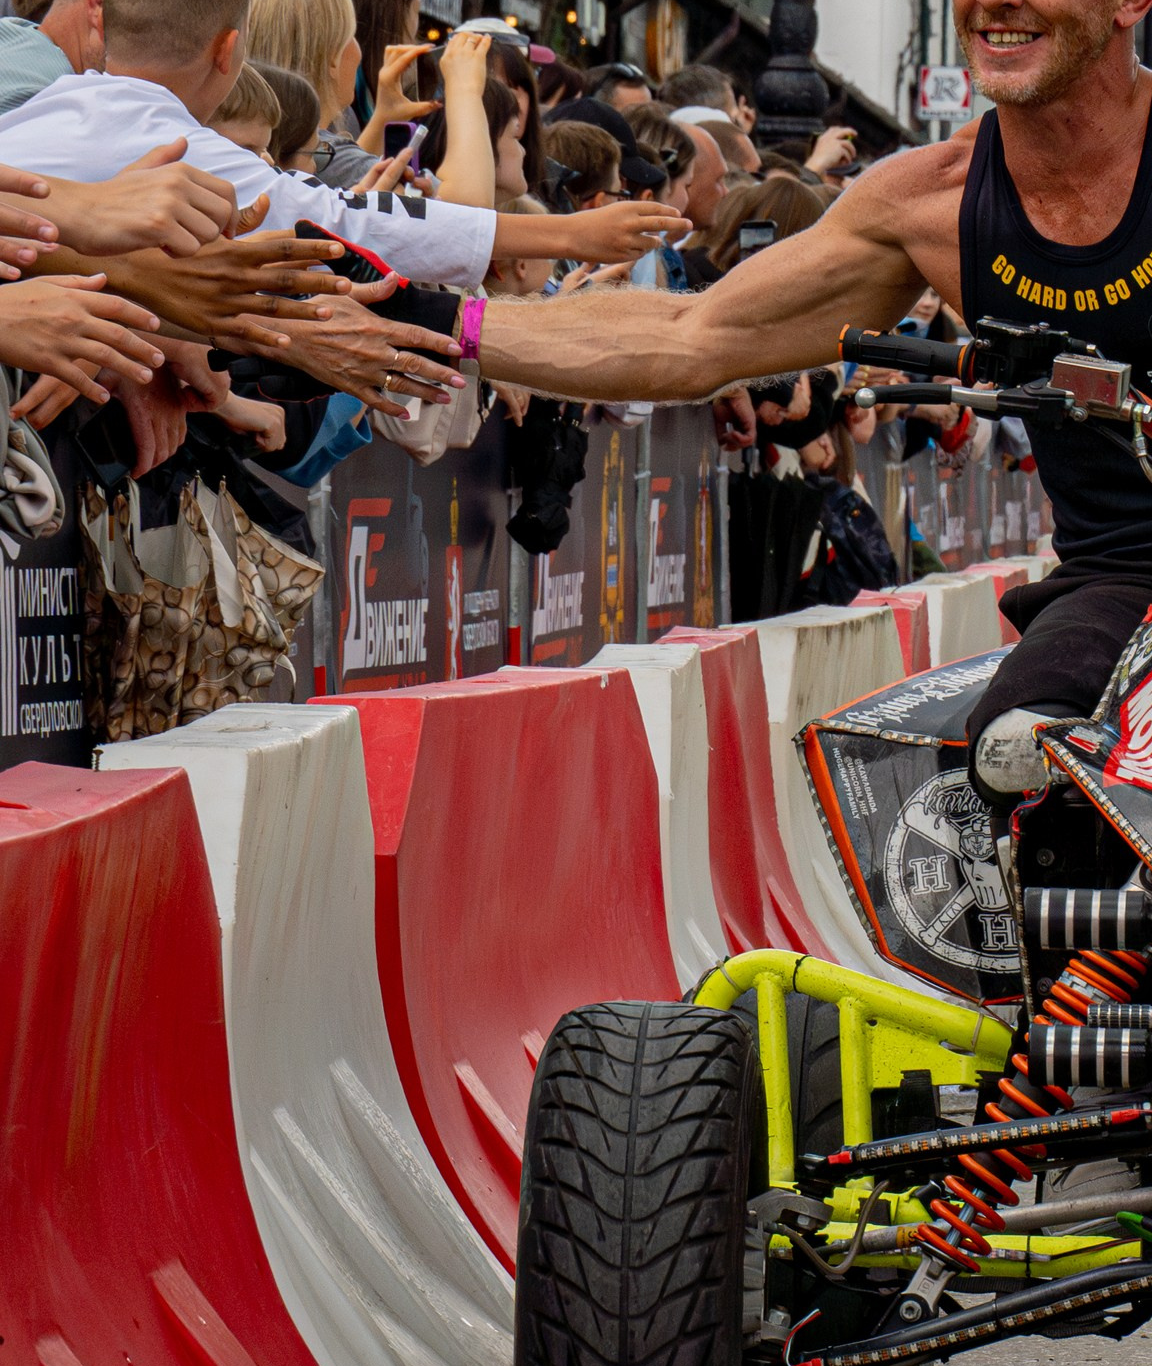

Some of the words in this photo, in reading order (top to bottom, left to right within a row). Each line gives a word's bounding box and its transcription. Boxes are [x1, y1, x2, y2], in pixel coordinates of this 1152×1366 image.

[992, 254, 1016, 285] GO
[1016, 275, 1067, 311] HARD
[1074, 289, 1100, 312] OR
[1103, 278, 1131, 305] GO
[853, 757, 878, 814] @KAWABANDA
[909, 854, 951, 895] H
[979, 914, 1018, 950] H
